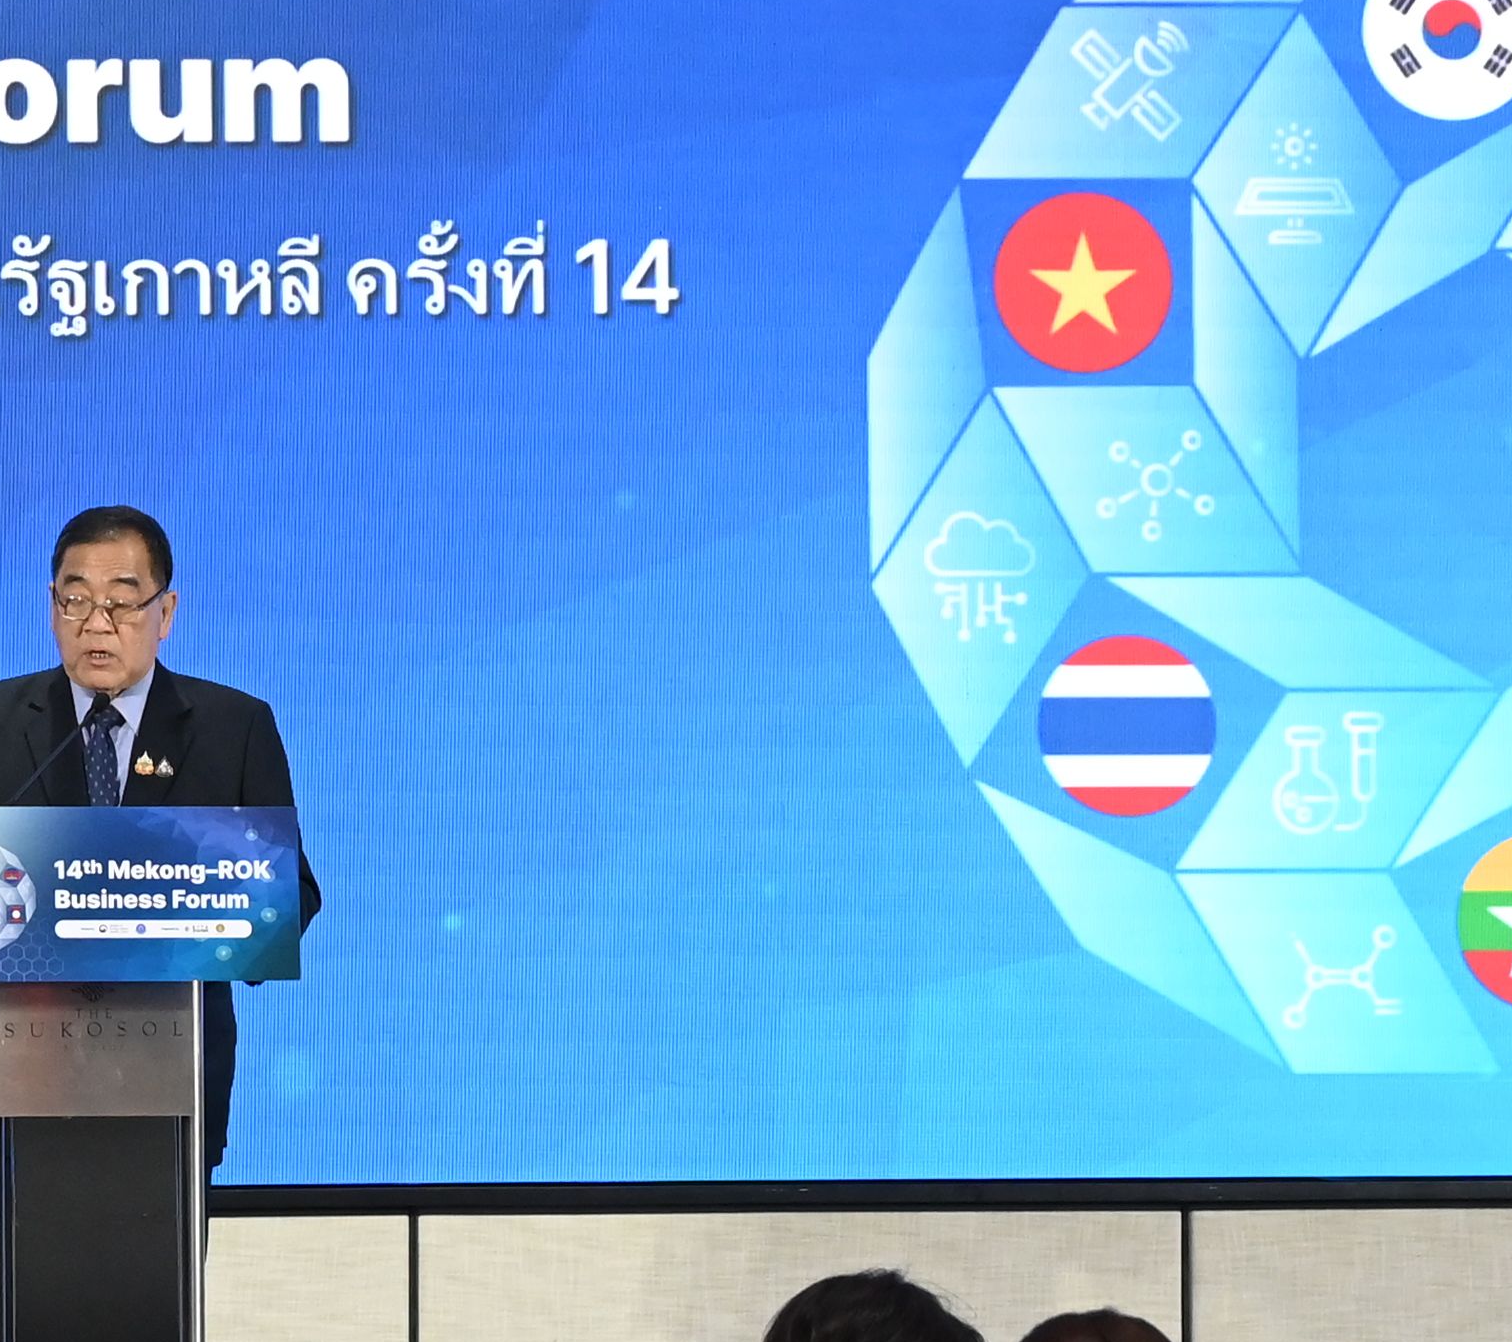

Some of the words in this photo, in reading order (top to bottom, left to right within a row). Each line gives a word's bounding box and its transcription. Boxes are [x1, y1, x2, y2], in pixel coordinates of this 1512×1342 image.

[346, 219, 546, 316] ครั้งที่
[575, 236, 680, 315] 14
[53, 859, 103, 881] 14th
[53, 888, 168, 910] Business
[172, 887, 251, 910] Forum
[76, 1008, 113, 1020] THE
[3, 1020, 184, 1039] SUKOSOL
